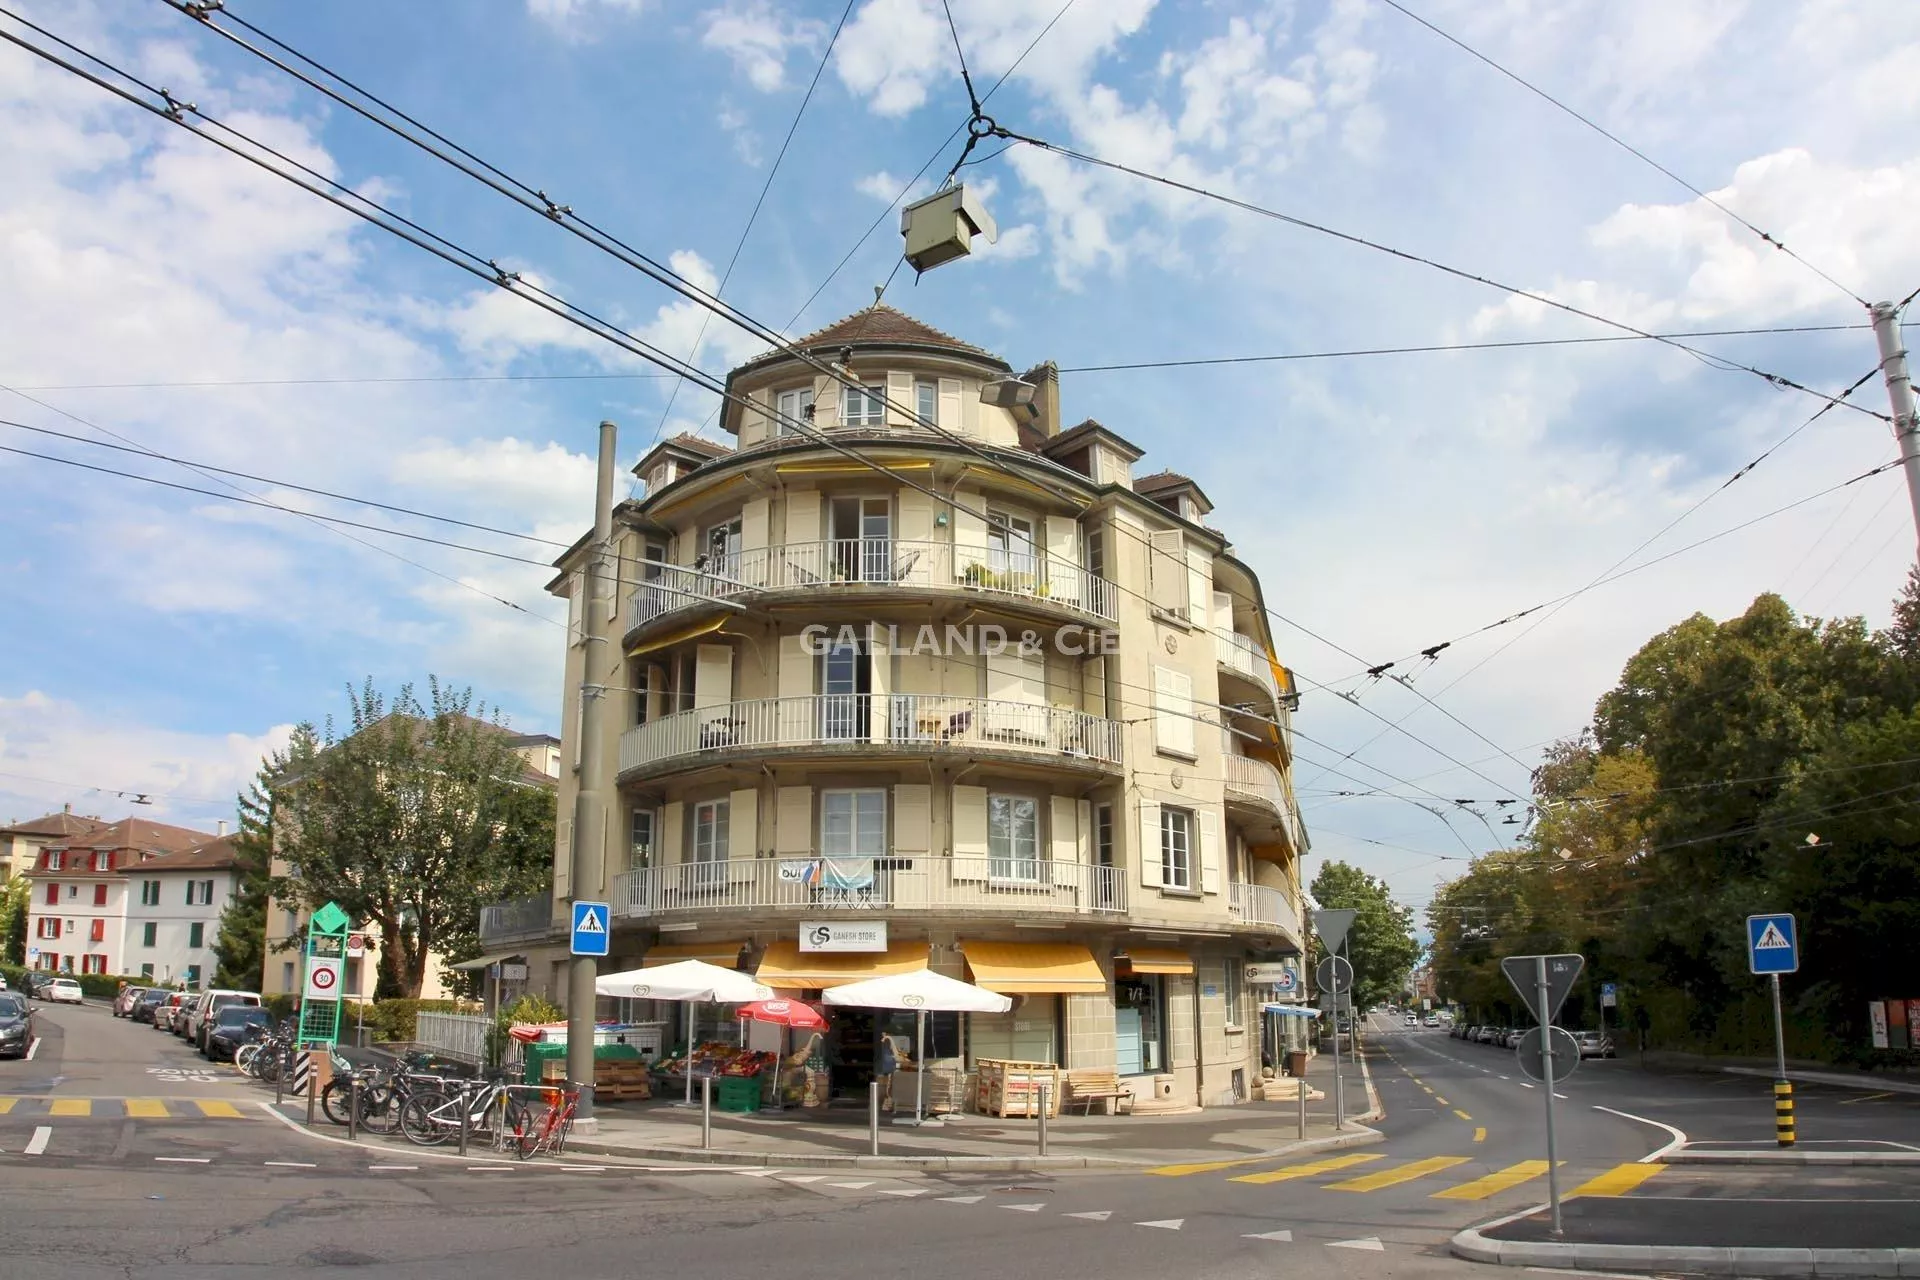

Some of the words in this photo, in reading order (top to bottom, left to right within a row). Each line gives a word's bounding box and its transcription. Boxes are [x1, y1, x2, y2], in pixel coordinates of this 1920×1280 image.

[782, 869, 801, 878] OUI
[859, 932, 876, 941] STORE
[319, 974, 329, 983] 30
[156, 1075, 219, 1083] 30
